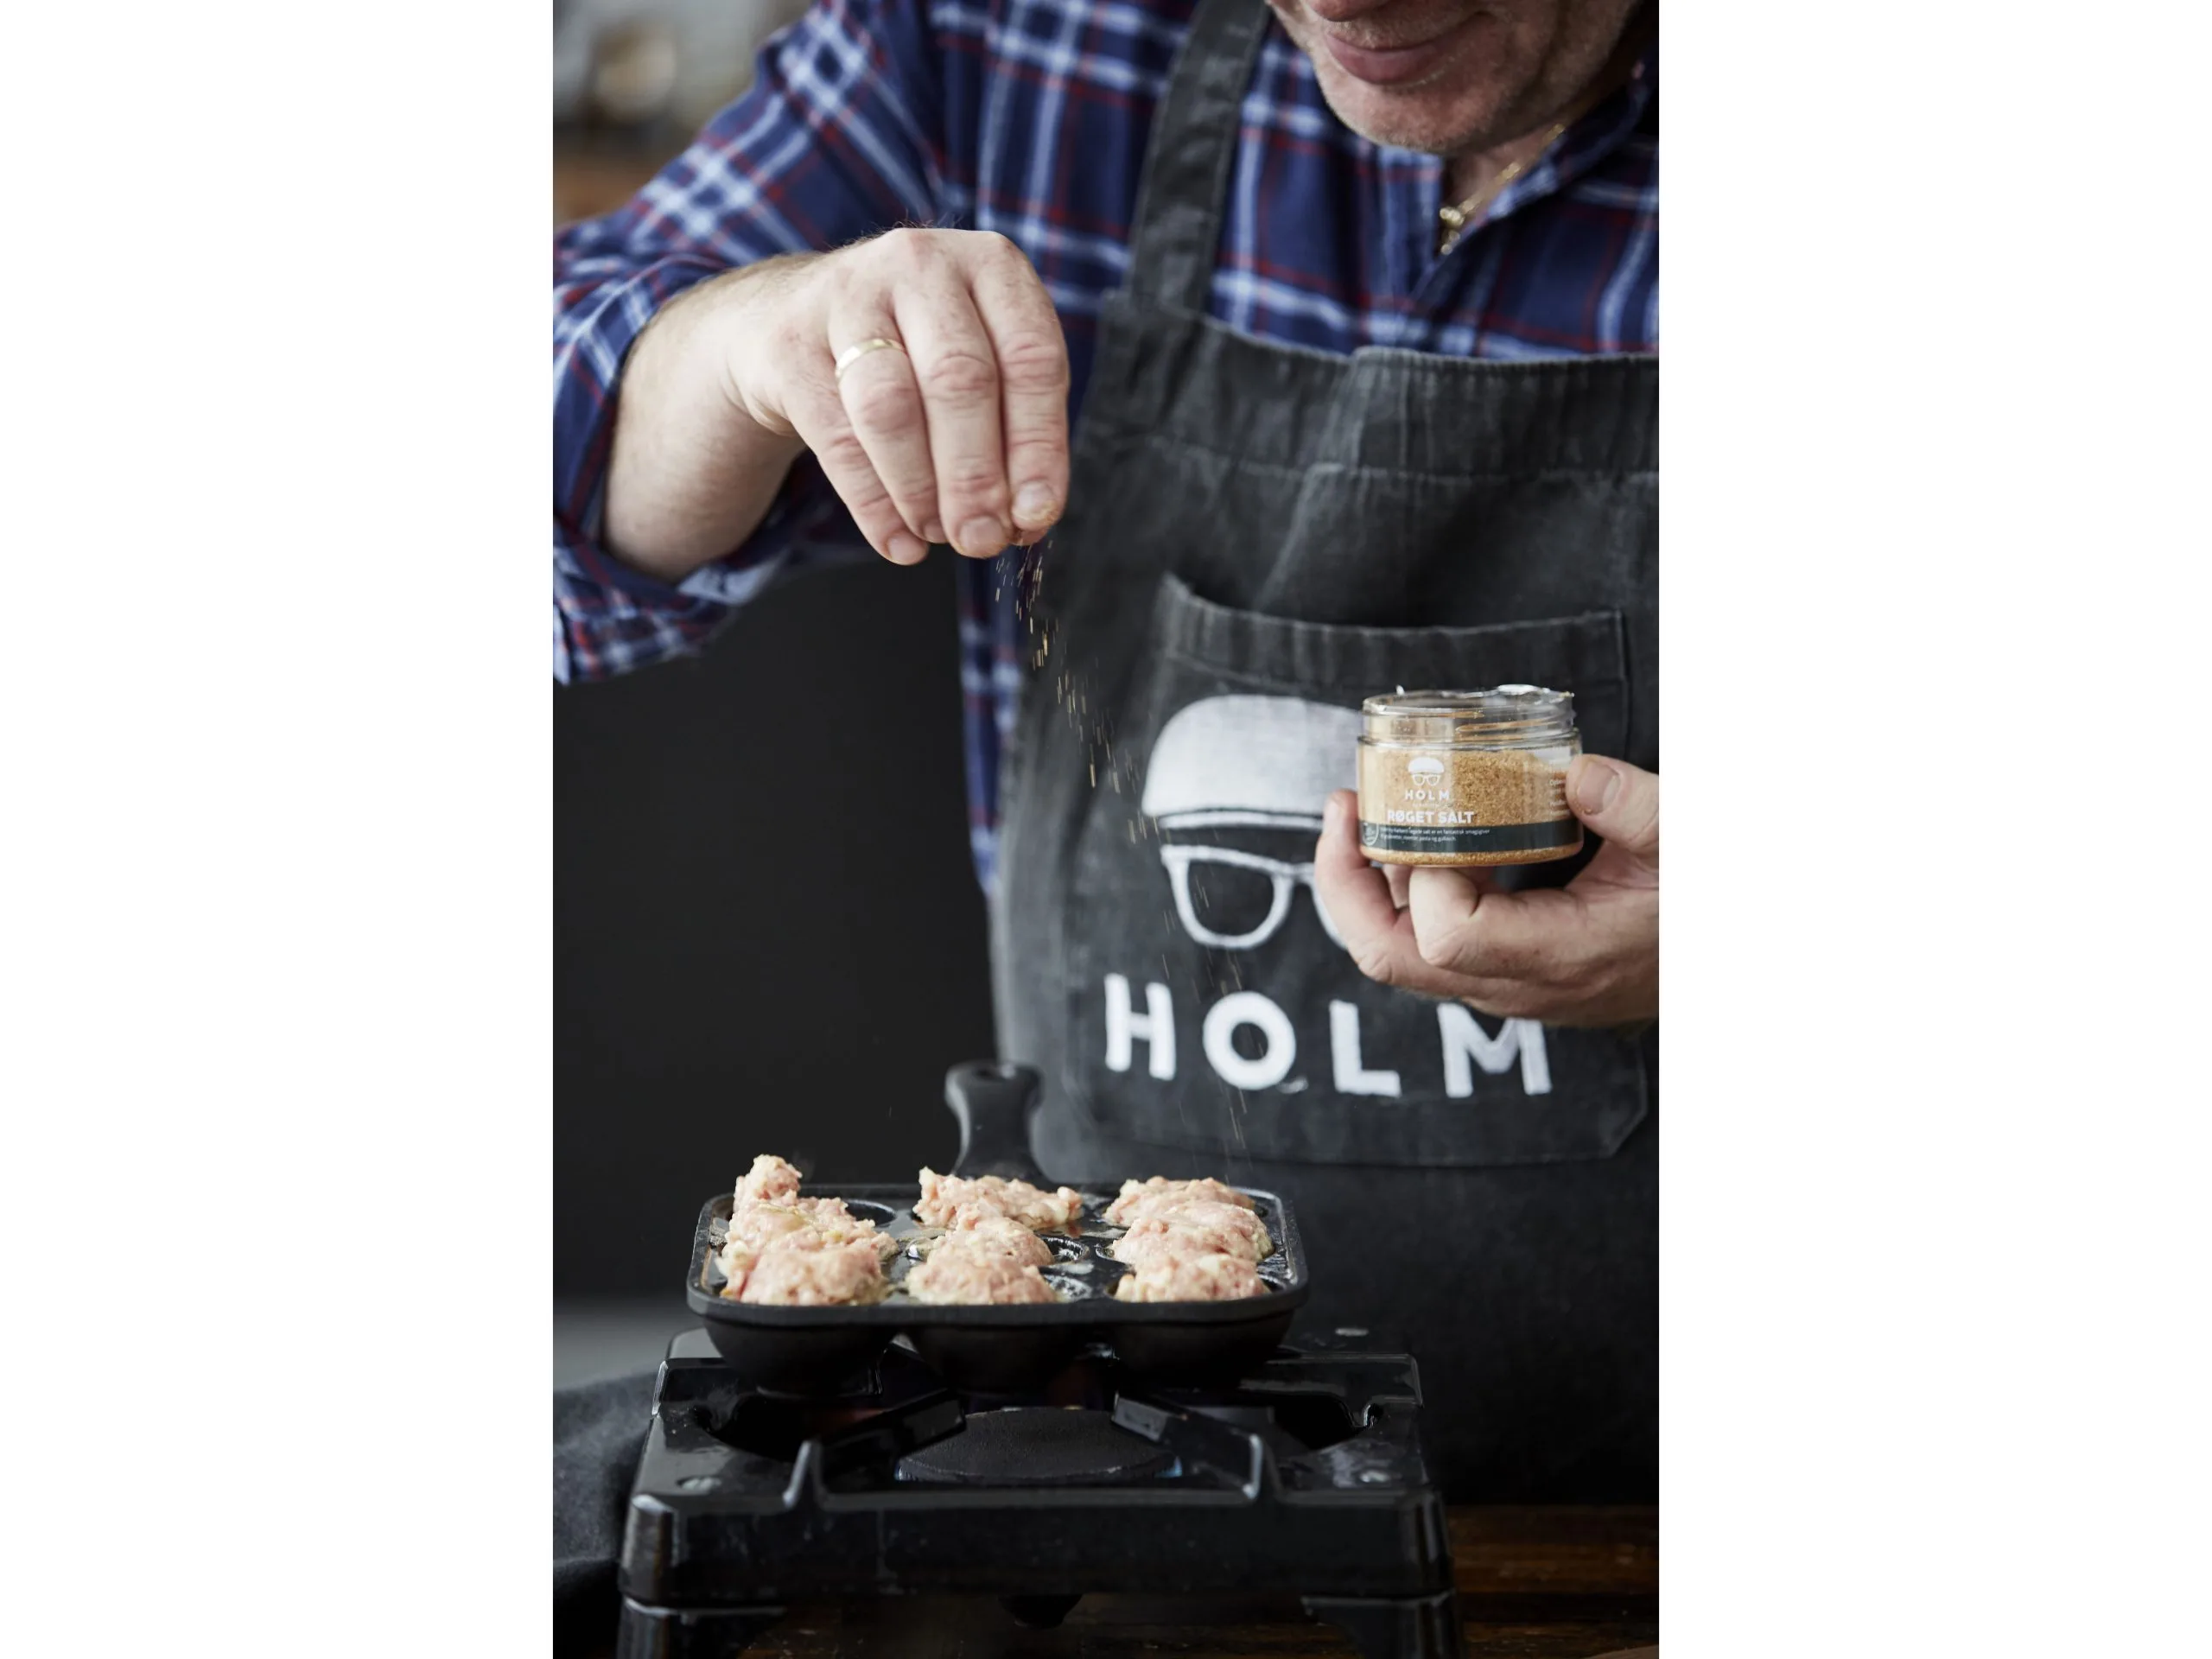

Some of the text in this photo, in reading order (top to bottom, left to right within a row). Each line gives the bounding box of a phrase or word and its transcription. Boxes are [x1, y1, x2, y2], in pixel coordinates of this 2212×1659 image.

[1405, 789, 1450, 802] HOLM
[1388, 810, 1474, 824] RØGET SALT
[1104, 973, 1553, 1099] HOLM
